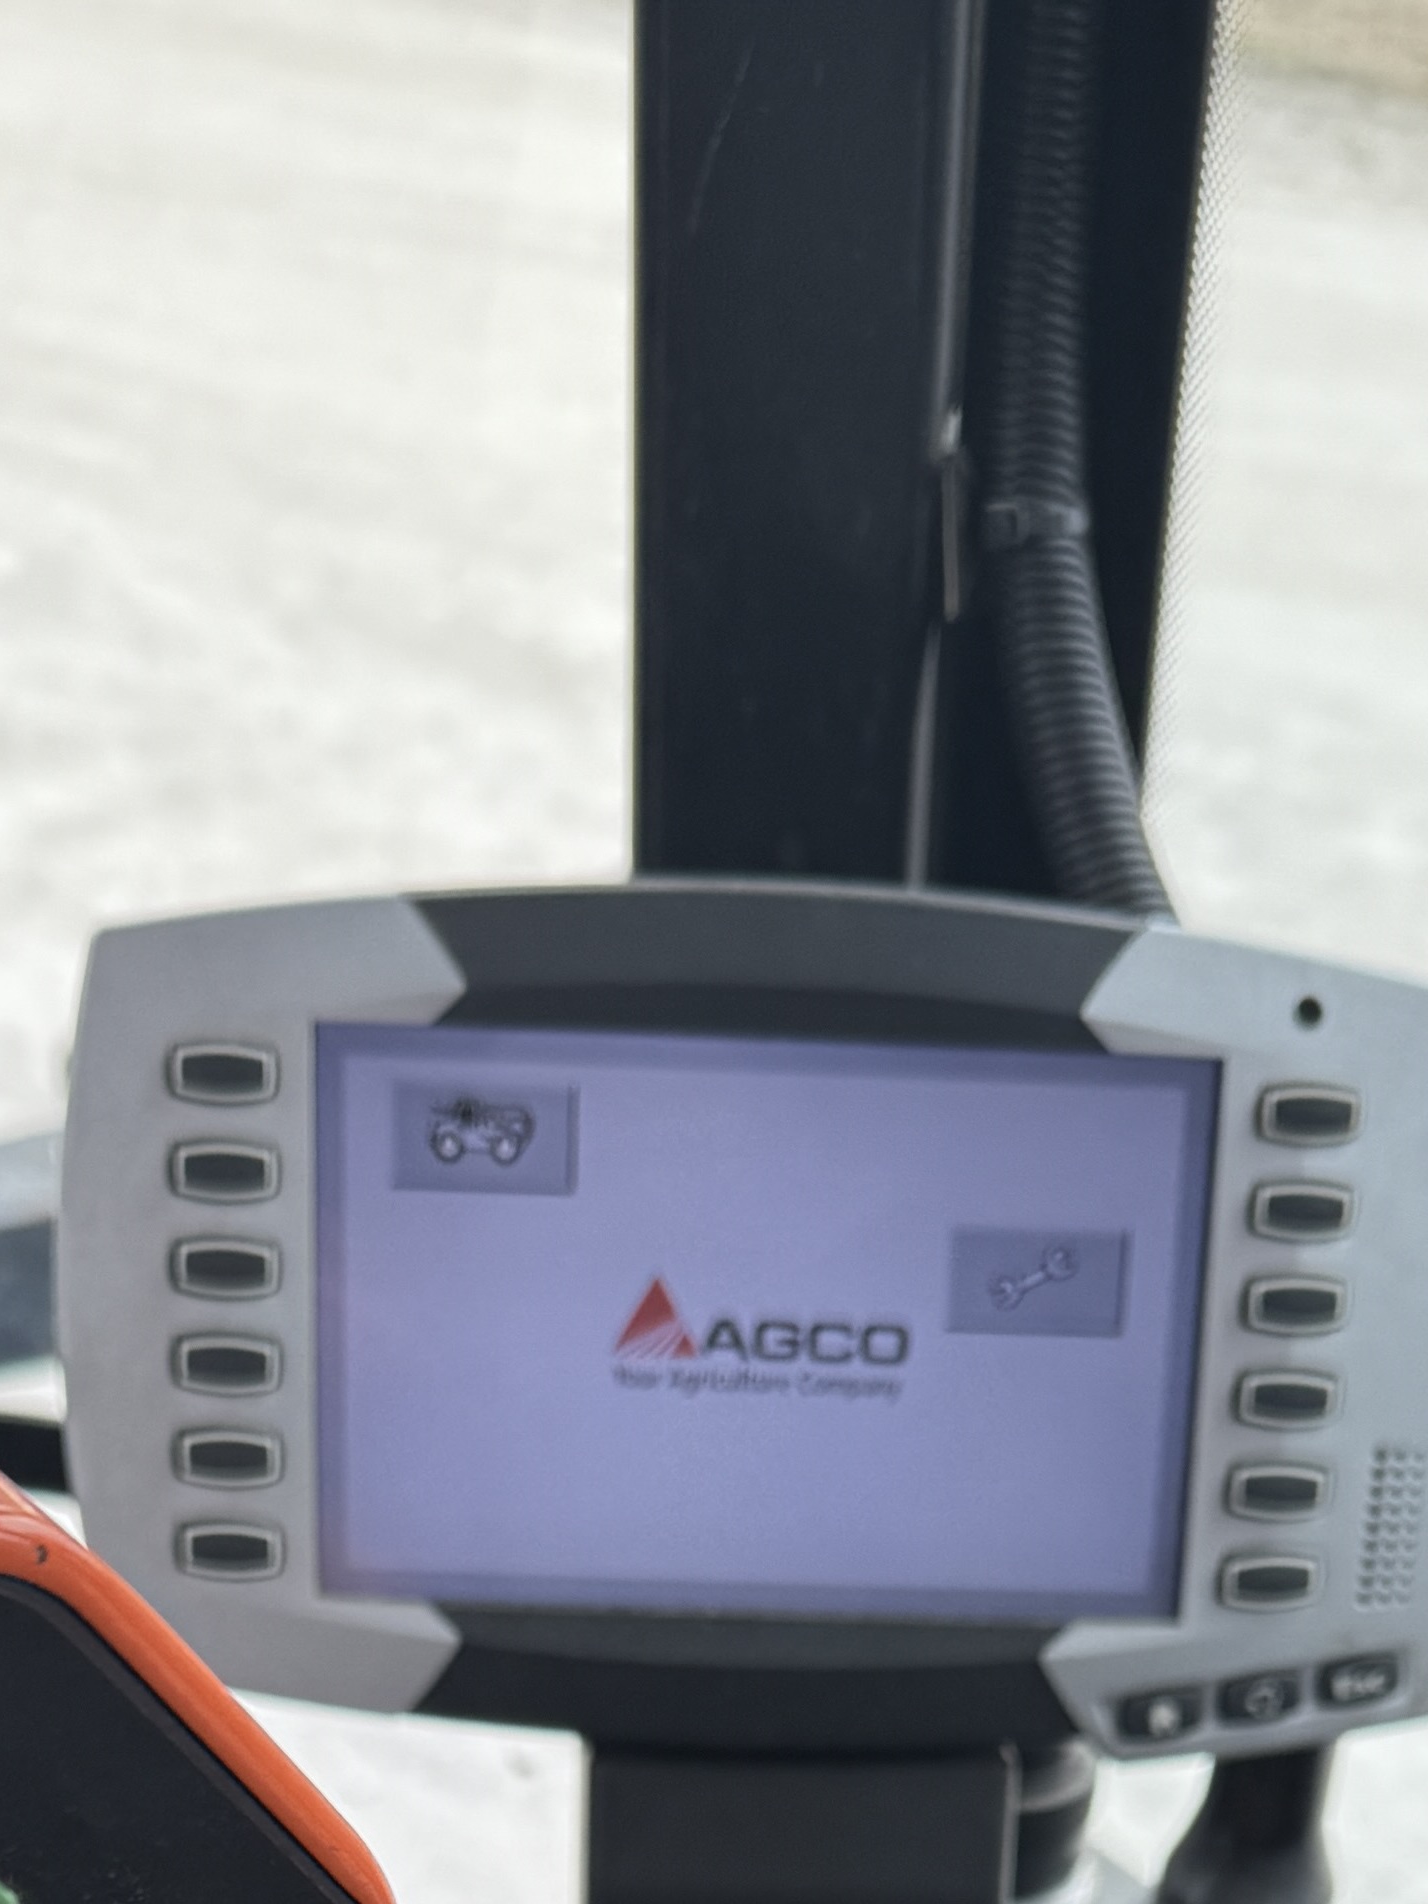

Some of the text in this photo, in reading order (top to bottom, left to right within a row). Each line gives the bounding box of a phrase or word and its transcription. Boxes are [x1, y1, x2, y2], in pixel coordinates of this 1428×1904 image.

[703, 1316, 911, 1366] AGCO
[669, 1366, 791, 1398] Agriculture
[796, 1369, 903, 1401] Company
